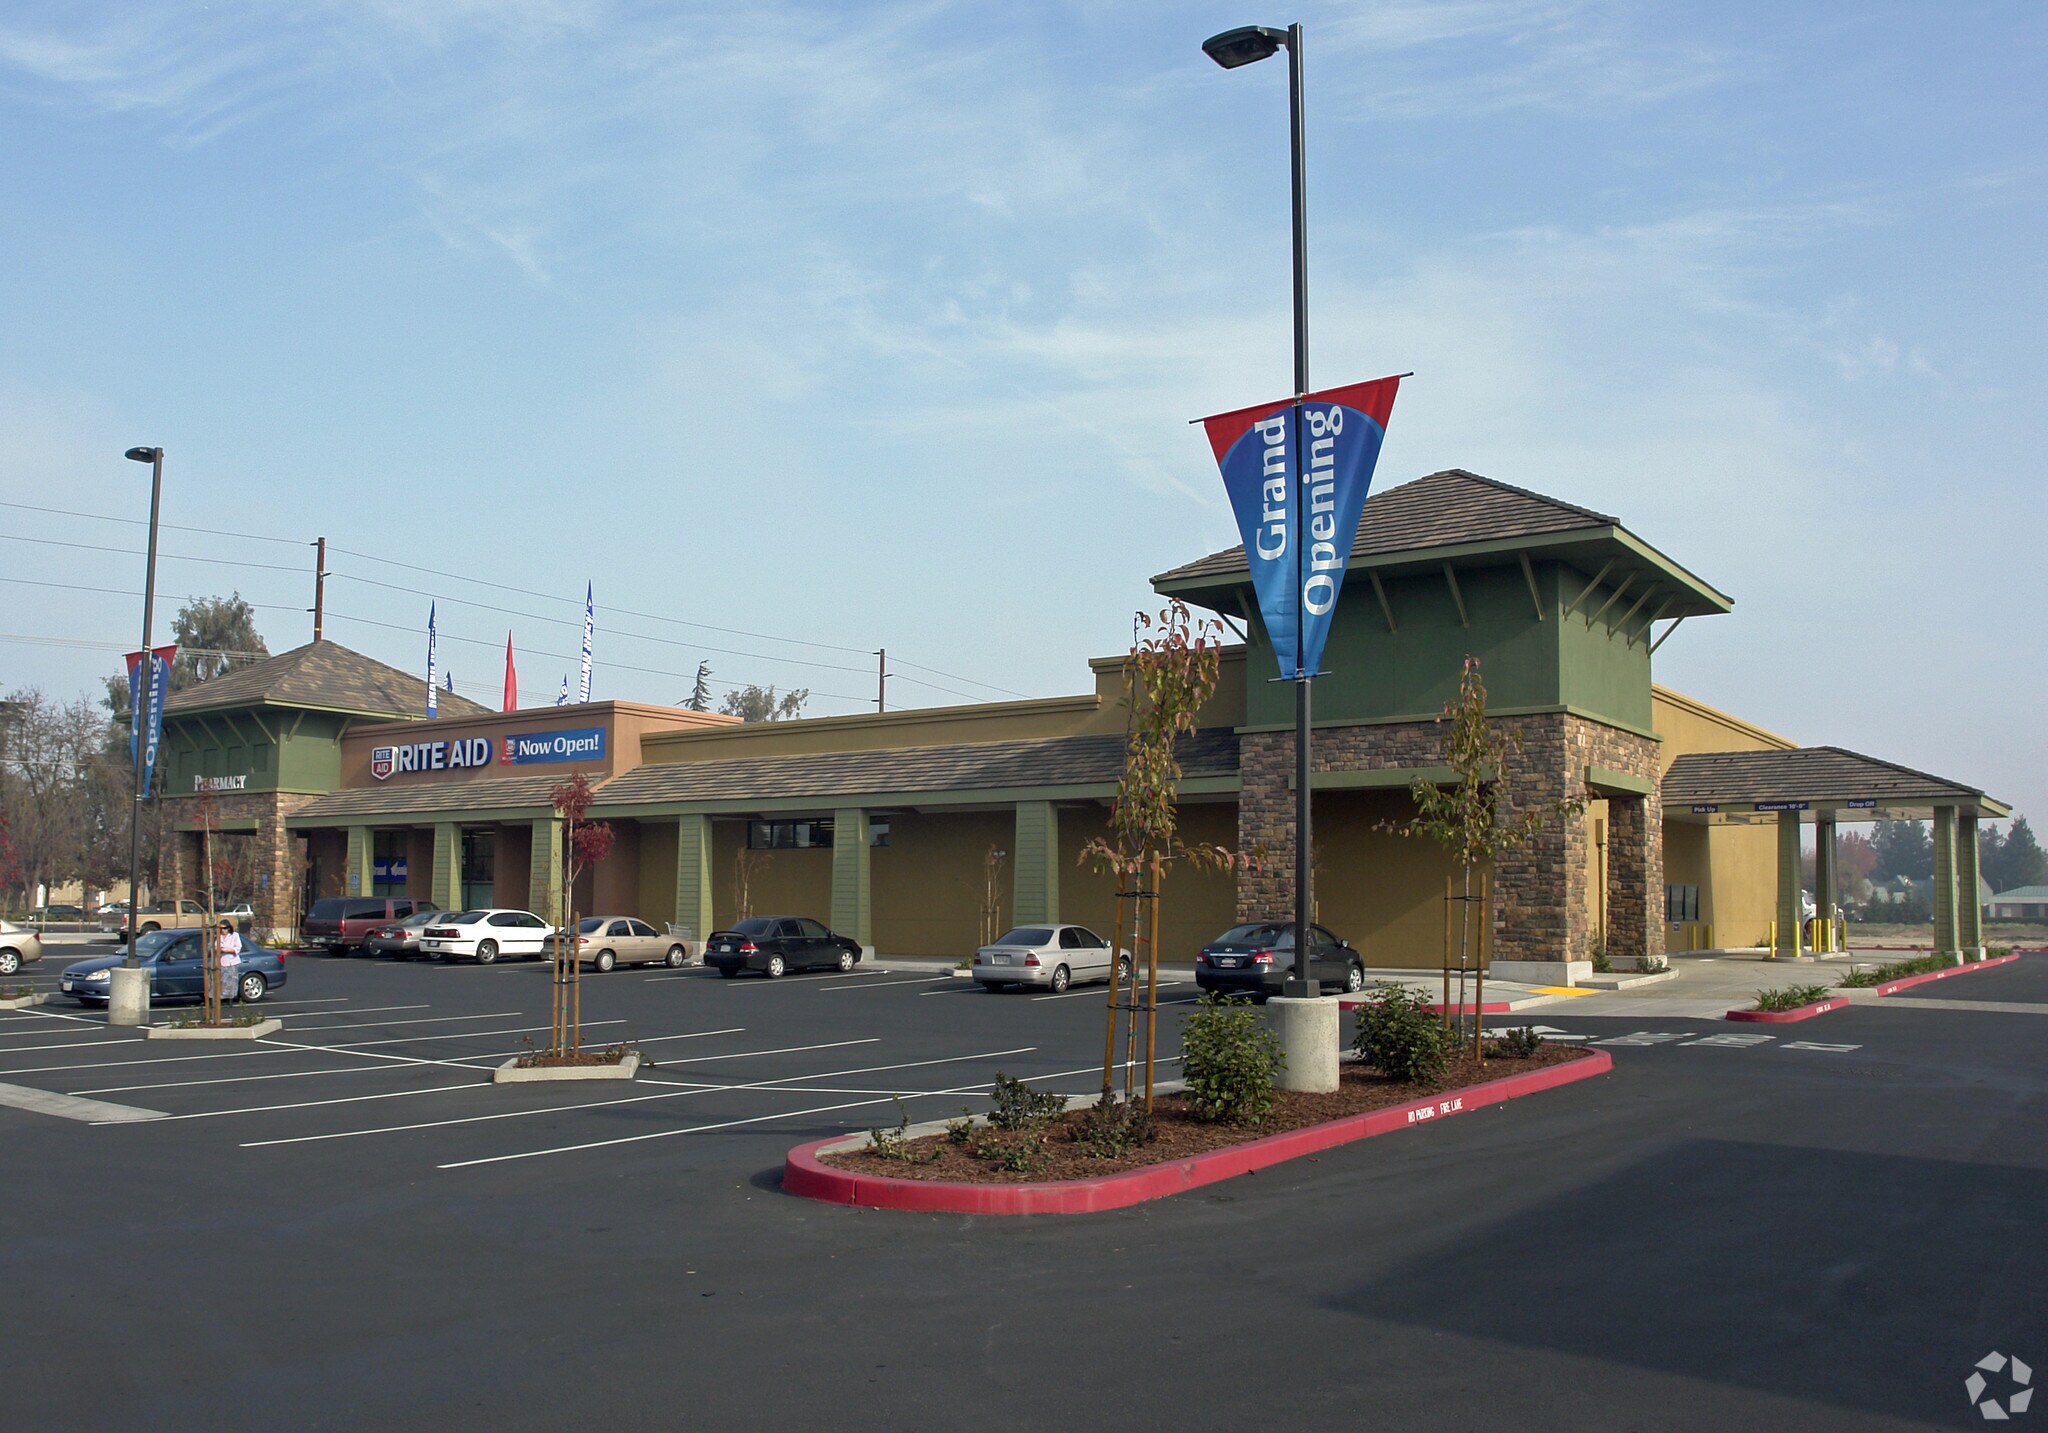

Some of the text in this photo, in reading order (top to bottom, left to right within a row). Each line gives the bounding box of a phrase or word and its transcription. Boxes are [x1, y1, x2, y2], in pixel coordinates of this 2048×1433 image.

[1254, 415, 1287, 561] Grand
[1303, 405, 1343, 616] Opening
[145, 656, 163, 767] Opening
[375, 750, 391, 760] RITE
[399, 741, 446, 772] RITE
[449, 738, 490, 768] AID
[519, 740, 552, 756] Now
[553, 734, 599, 757] Open!
[376, 762, 389, 773] AID
[1758, 803, 1787, 811] Clearance
[1849, 801, 1863, 809] Drop
[1407, 1097, 1463, 1123] NO PARKING FIRE LANE
